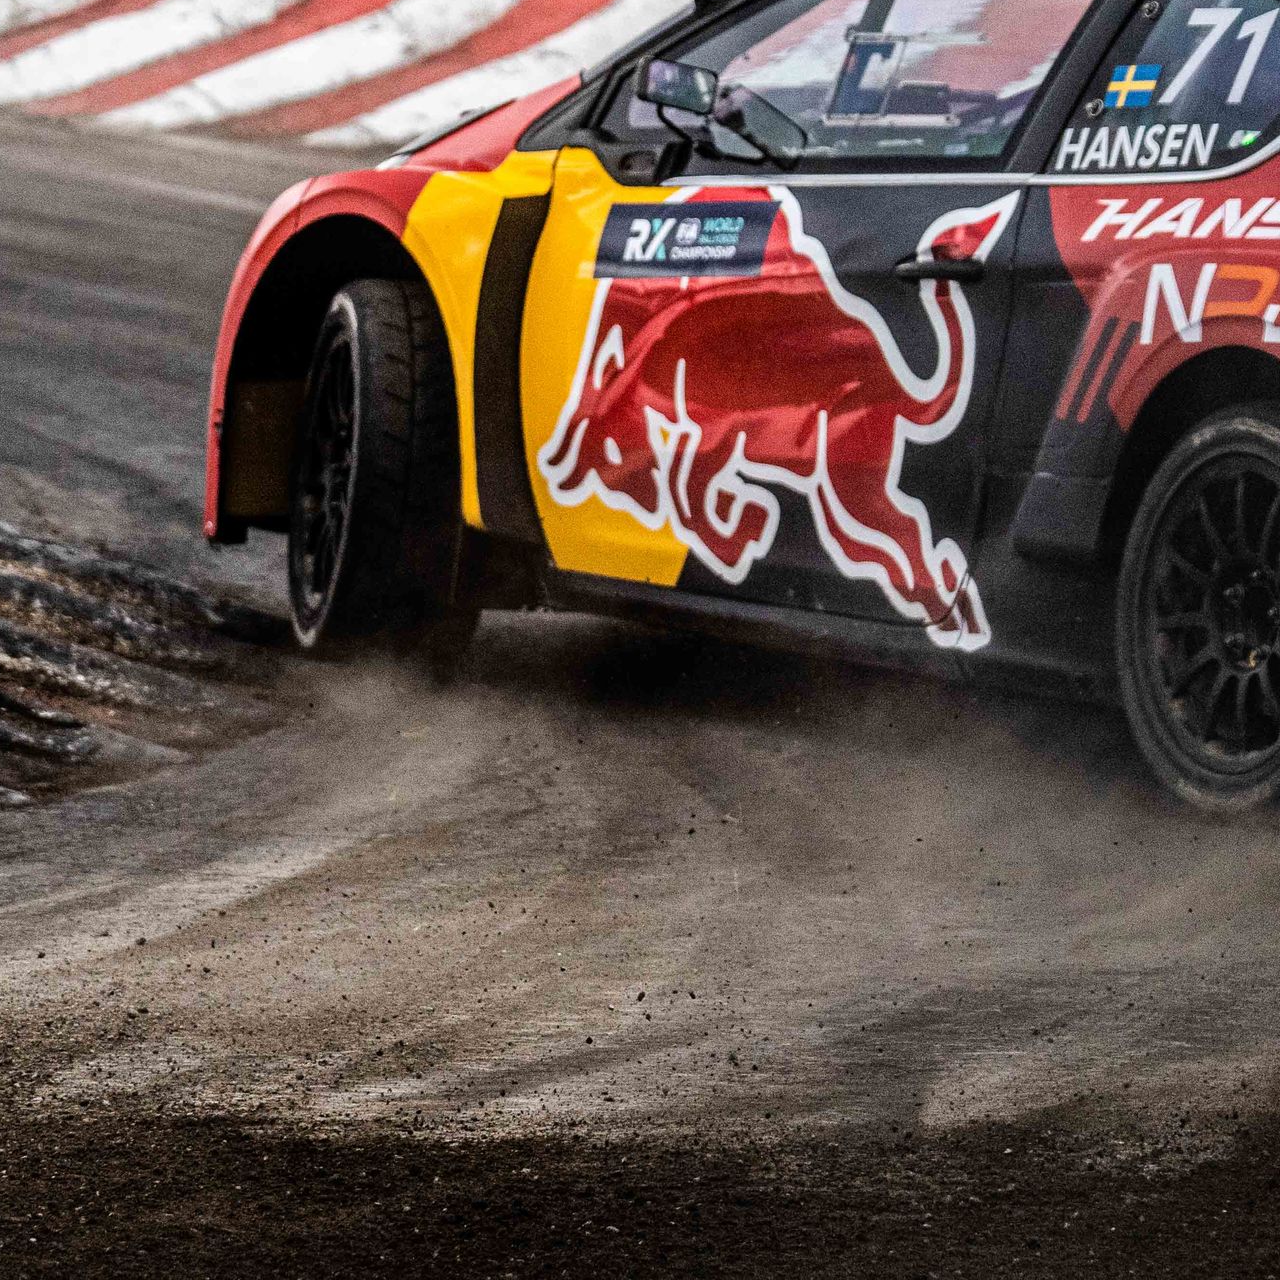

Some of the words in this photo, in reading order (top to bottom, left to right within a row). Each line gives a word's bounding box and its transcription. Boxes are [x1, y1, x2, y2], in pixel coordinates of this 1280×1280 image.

[1158, 7, 1280, 104] 71
[1054, 123, 1219, 170] HANSEN
[622, 217, 677, 261] RX
